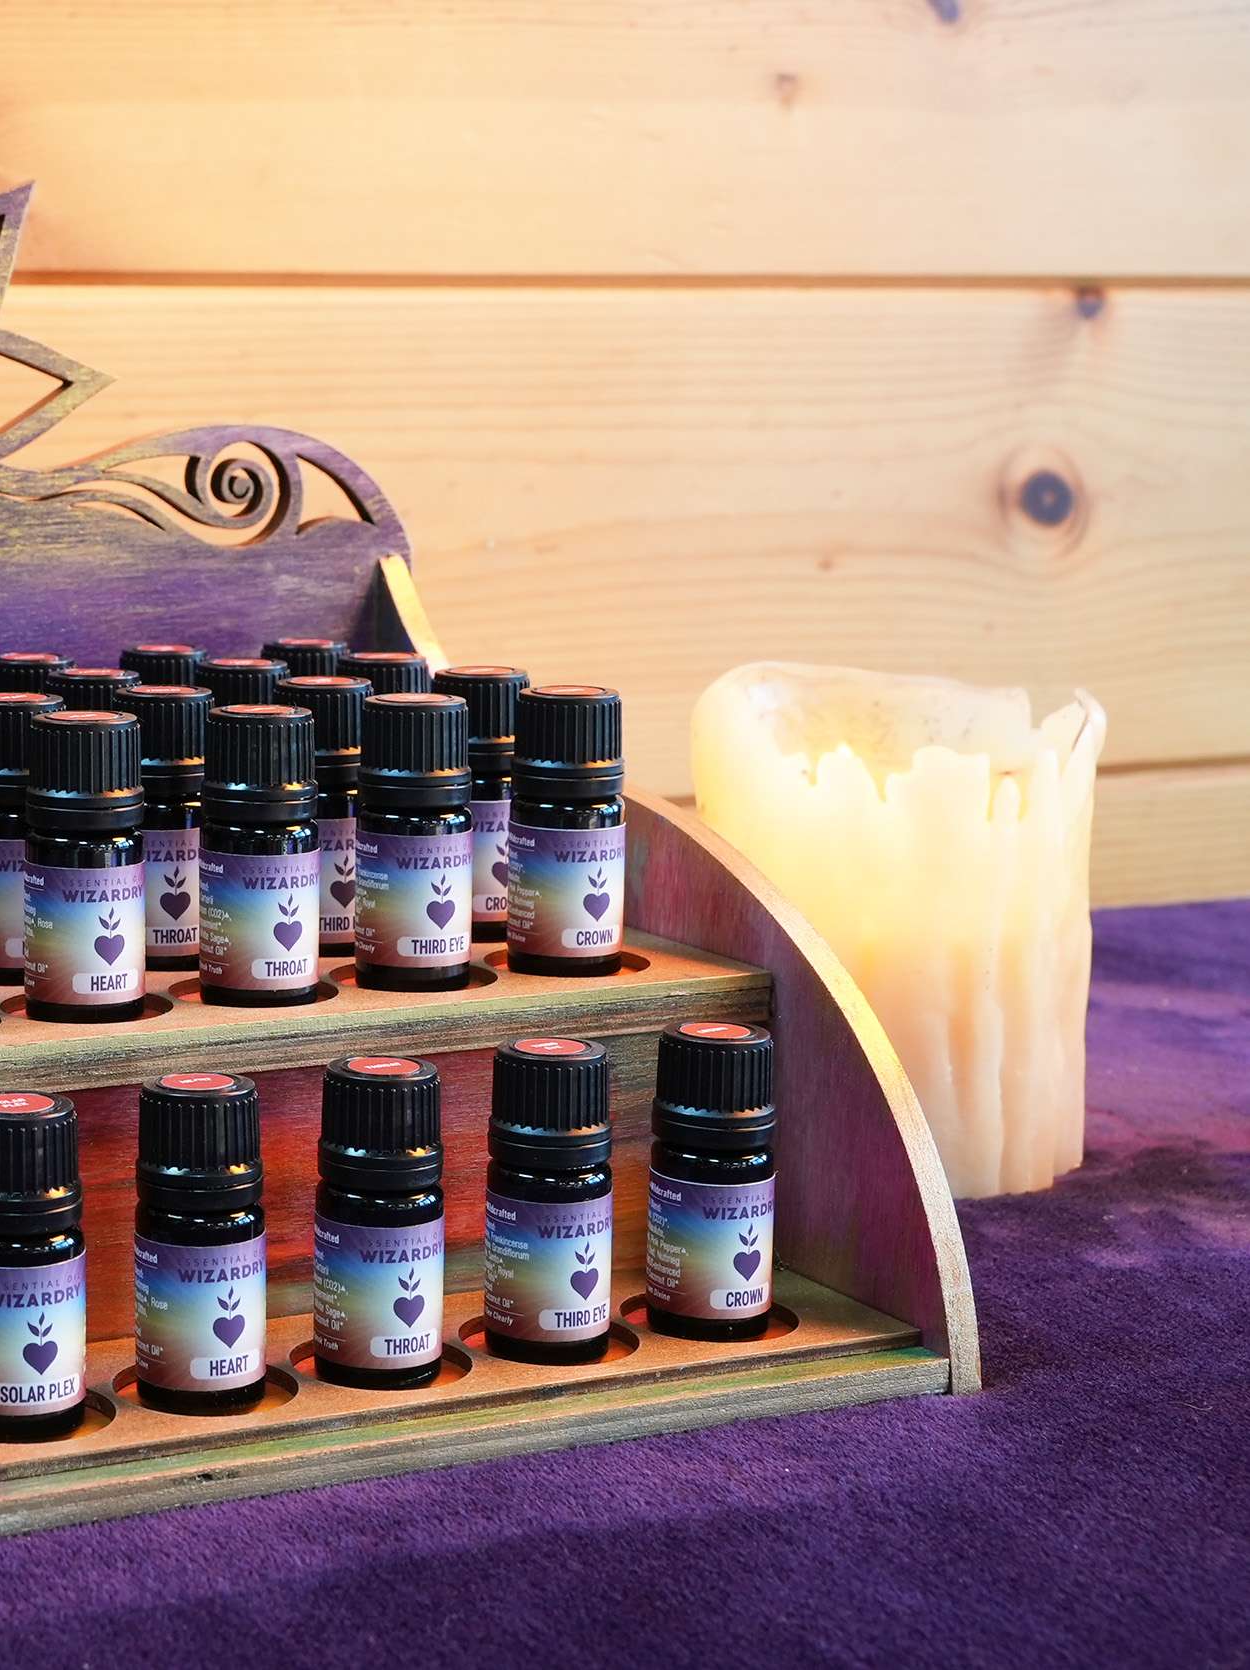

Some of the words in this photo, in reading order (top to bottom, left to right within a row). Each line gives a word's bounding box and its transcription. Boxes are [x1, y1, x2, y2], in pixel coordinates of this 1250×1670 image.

[554, 848, 623, 863] WIZARDR
[241, 875, 320, 890] WIZARDRY
[61, 885, 143, 903] WIZARDRY
[319, 916, 350, 932] THIRD
[153, 927, 198, 945] THROAT
[411, 938, 447, 955] THIRD
[449, 936, 464, 952] EYE
[576, 929, 613, 946] CROWN
[264, 958, 308, 977] THROAT
[90, 973, 128, 991] HEART
[702, 1200, 773, 1220] WIZARDR
[726, 1288, 763, 1307] CROWN
[554, 1311, 590, 1328] THIRD
[593, 1303, 606, 1323] EYE
[384, 1334, 430, 1355] THROAT
[210, 1355, 248, 1376] HEART
[0, 1383, 45, 1403] SOLAR
[49, 1377, 75, 1400] PLEX
